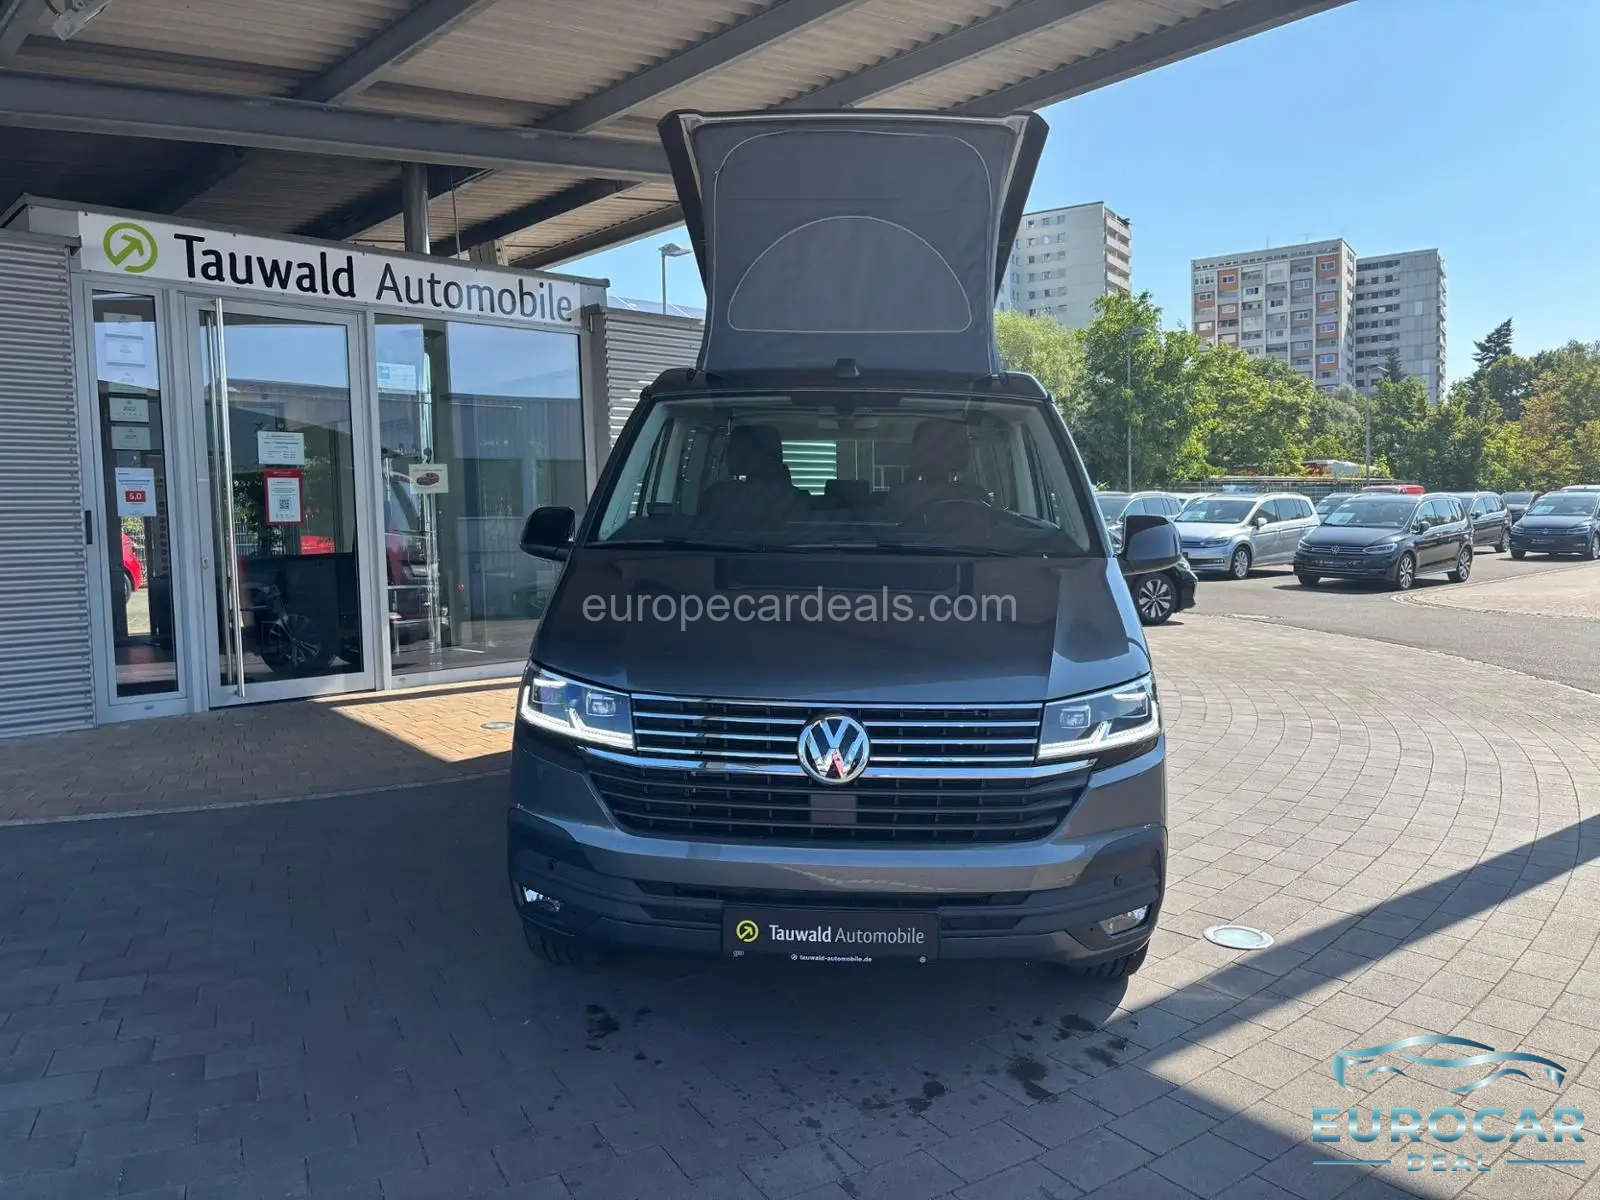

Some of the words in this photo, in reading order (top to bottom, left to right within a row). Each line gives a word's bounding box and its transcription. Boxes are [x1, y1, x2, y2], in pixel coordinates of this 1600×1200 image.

[173, 233, 356, 298] Tauwald
[375, 262, 572, 323] Automobile
[768, 924, 832, 943] Tauwald
[834, 927, 925, 945] Automobile
[799, 953, 873, 963] tauwald-automobile.de
